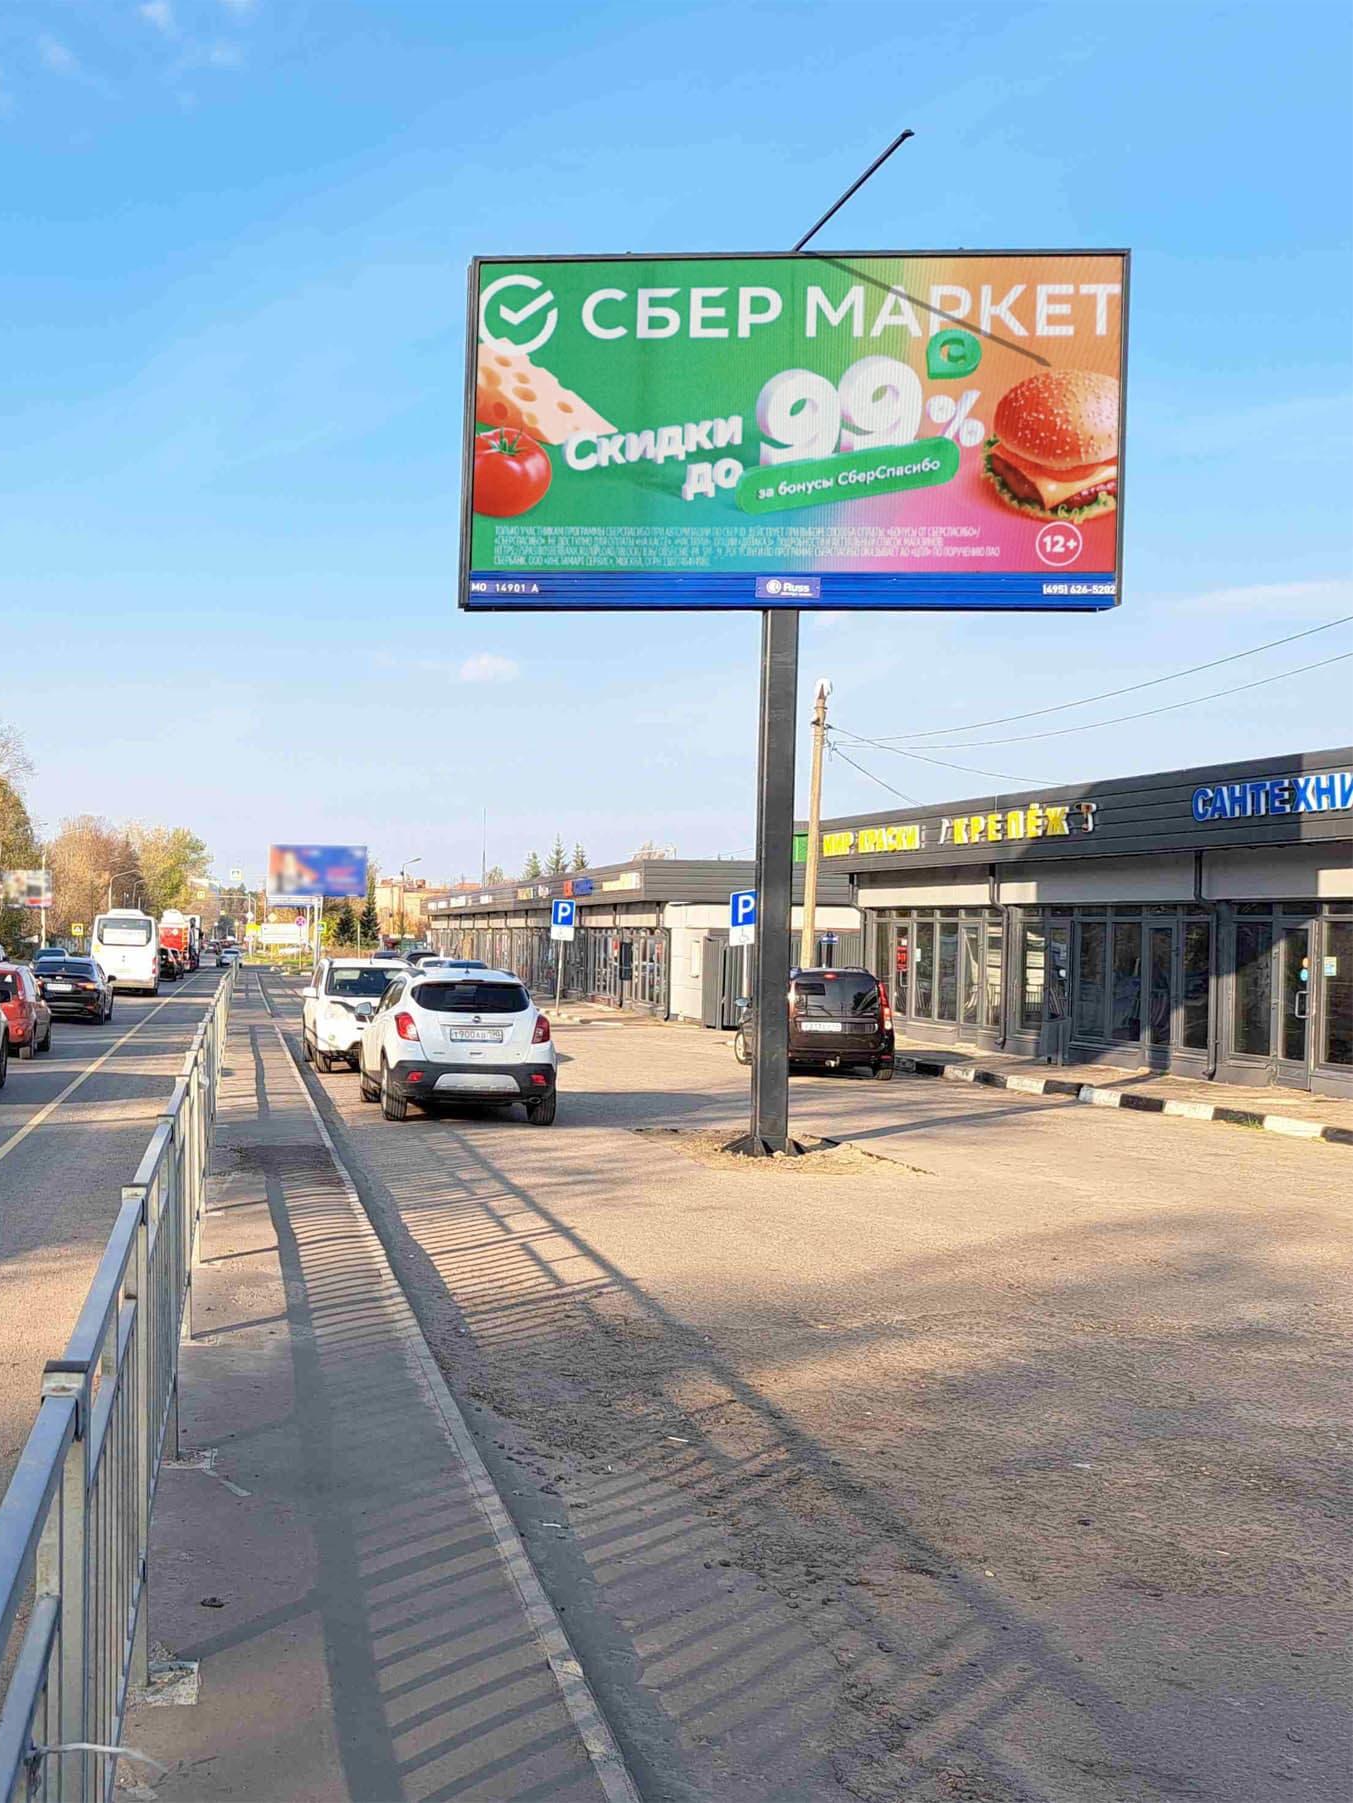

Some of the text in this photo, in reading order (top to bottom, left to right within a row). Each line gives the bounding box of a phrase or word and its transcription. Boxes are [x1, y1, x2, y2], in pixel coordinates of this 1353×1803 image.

[581, 283, 1122, 340] СБЕР МАРКЕТ
[562, 415, 743, 472] Скидки
[681, 457, 744, 501] до
[757, 457, 941, 500] за бонусы СберСпасибо
[1042, 535, 1078, 553] 12+
[471, 582, 540, 593] МО 14901 А
[783, 582, 810, 593] Russ
[1070, 584, 1117, 595] 626-5202
[952, 803, 1070, 845] КРЕПЁЖ
[857, 825, 920, 854] КРАСКИ
[557, 902, 572, 924] P
[737, 894, 755, 924] P
